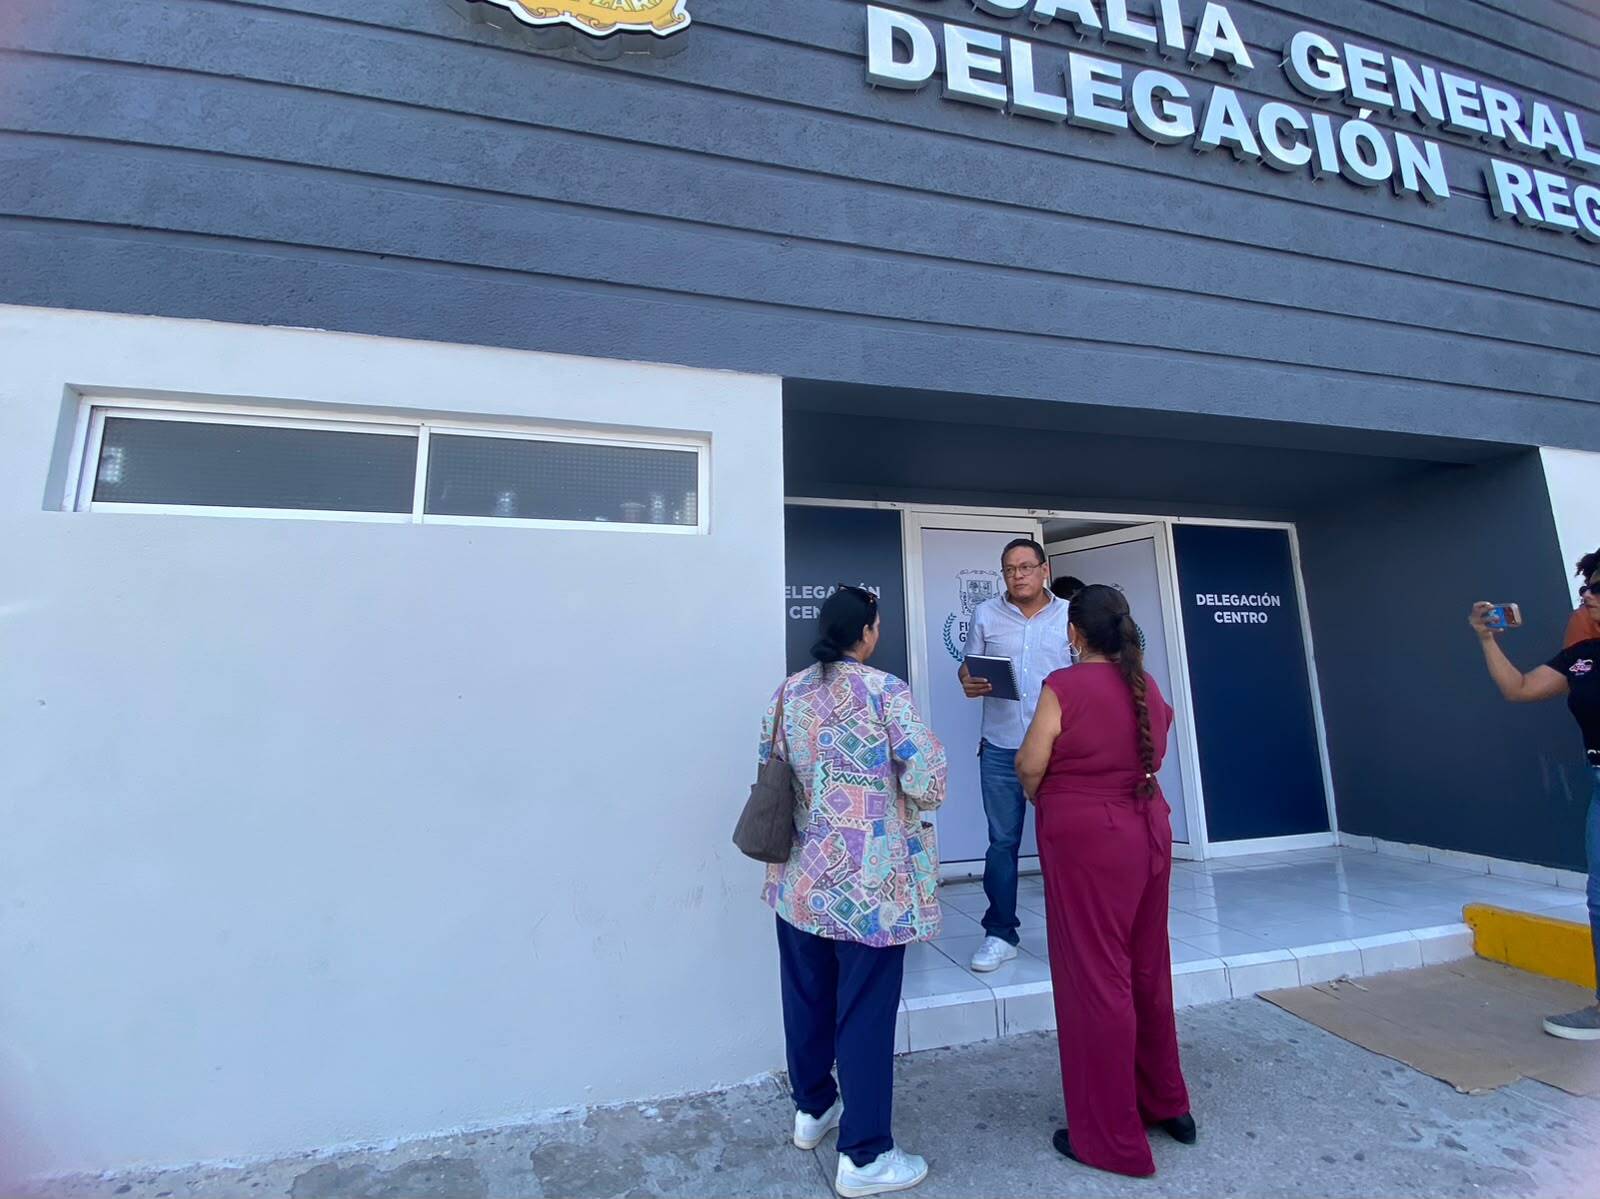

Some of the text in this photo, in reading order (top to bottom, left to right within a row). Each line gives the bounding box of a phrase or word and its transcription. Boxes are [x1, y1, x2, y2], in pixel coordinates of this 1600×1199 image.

[866, 4, 1450, 199] DELEGACIÓN
[1290, 30, 1600, 166] GENERAL
[1196, 592, 1281, 607] DELEGACIÓN
[1214, 611, 1268, 624] CENTRO
